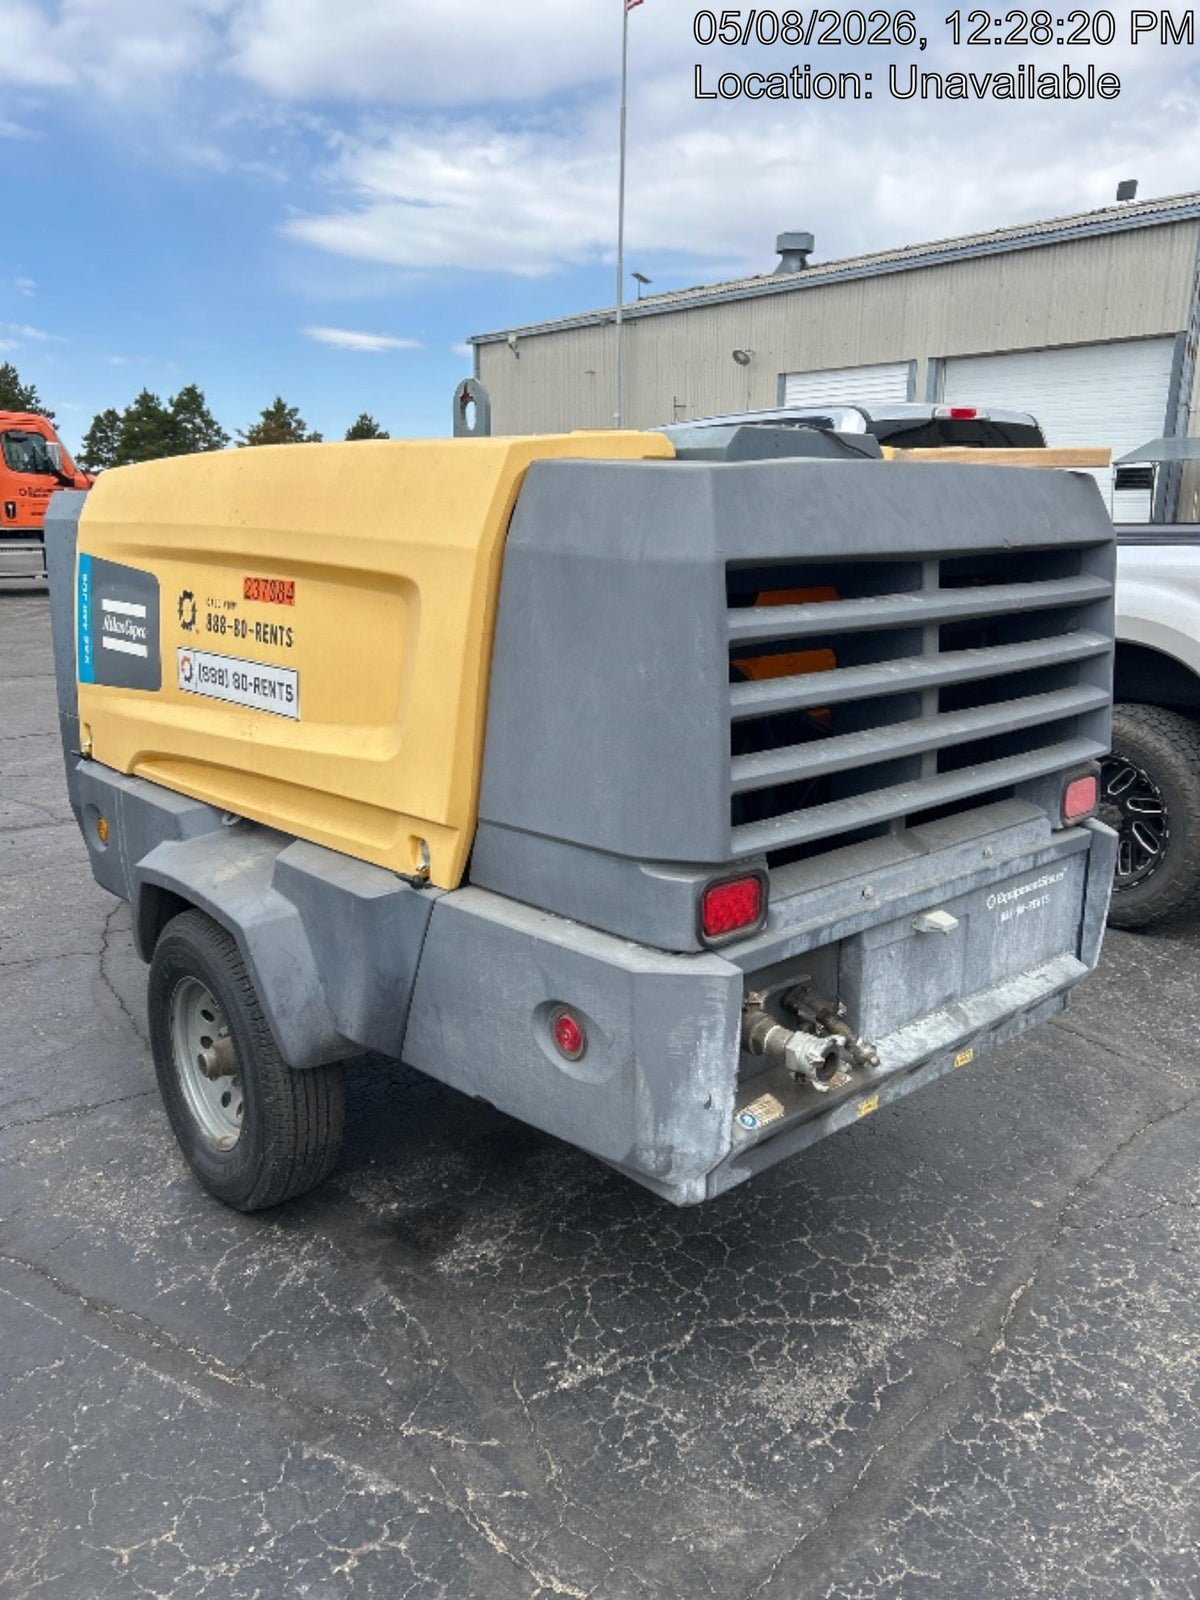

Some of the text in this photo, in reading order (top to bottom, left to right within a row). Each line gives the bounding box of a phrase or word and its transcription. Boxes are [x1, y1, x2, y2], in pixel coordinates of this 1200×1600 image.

[206, 613, 294, 648] 888-80-RENTS
[198, 663, 294, 703] (888) 80-RENTS
